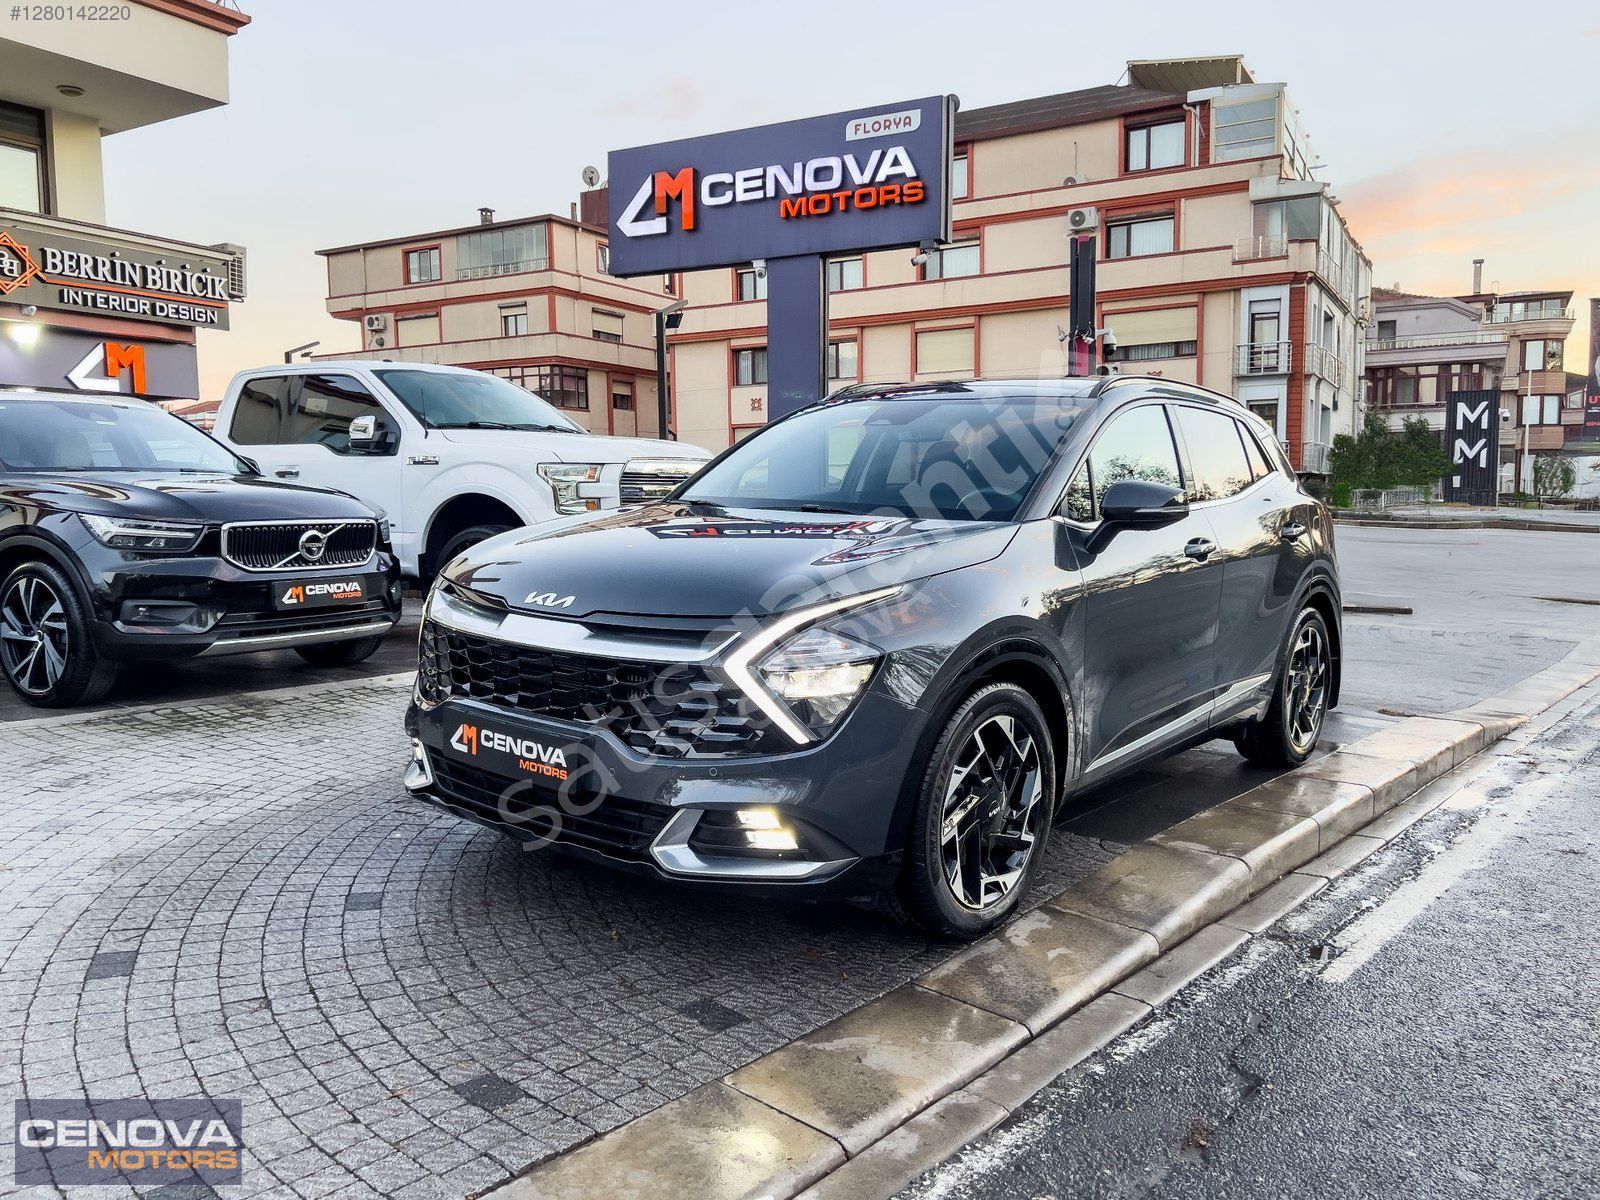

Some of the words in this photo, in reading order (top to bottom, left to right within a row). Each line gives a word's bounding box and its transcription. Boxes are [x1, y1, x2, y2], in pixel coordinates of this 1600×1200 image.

[854, 115, 912, 136] FLORYA
[701, 145, 918, 206] CENOVA
[780, 181, 925, 219] MOTORS
[63, 288, 151, 316] INTERIOR
[155, 301, 219, 324] DESIGN
[305, 582, 362, 596] CENOVA
[332, 591, 363, 600] MOTORS
[480, 729, 568, 768] CENOVA
[518, 758, 569, 781] MOTORS
